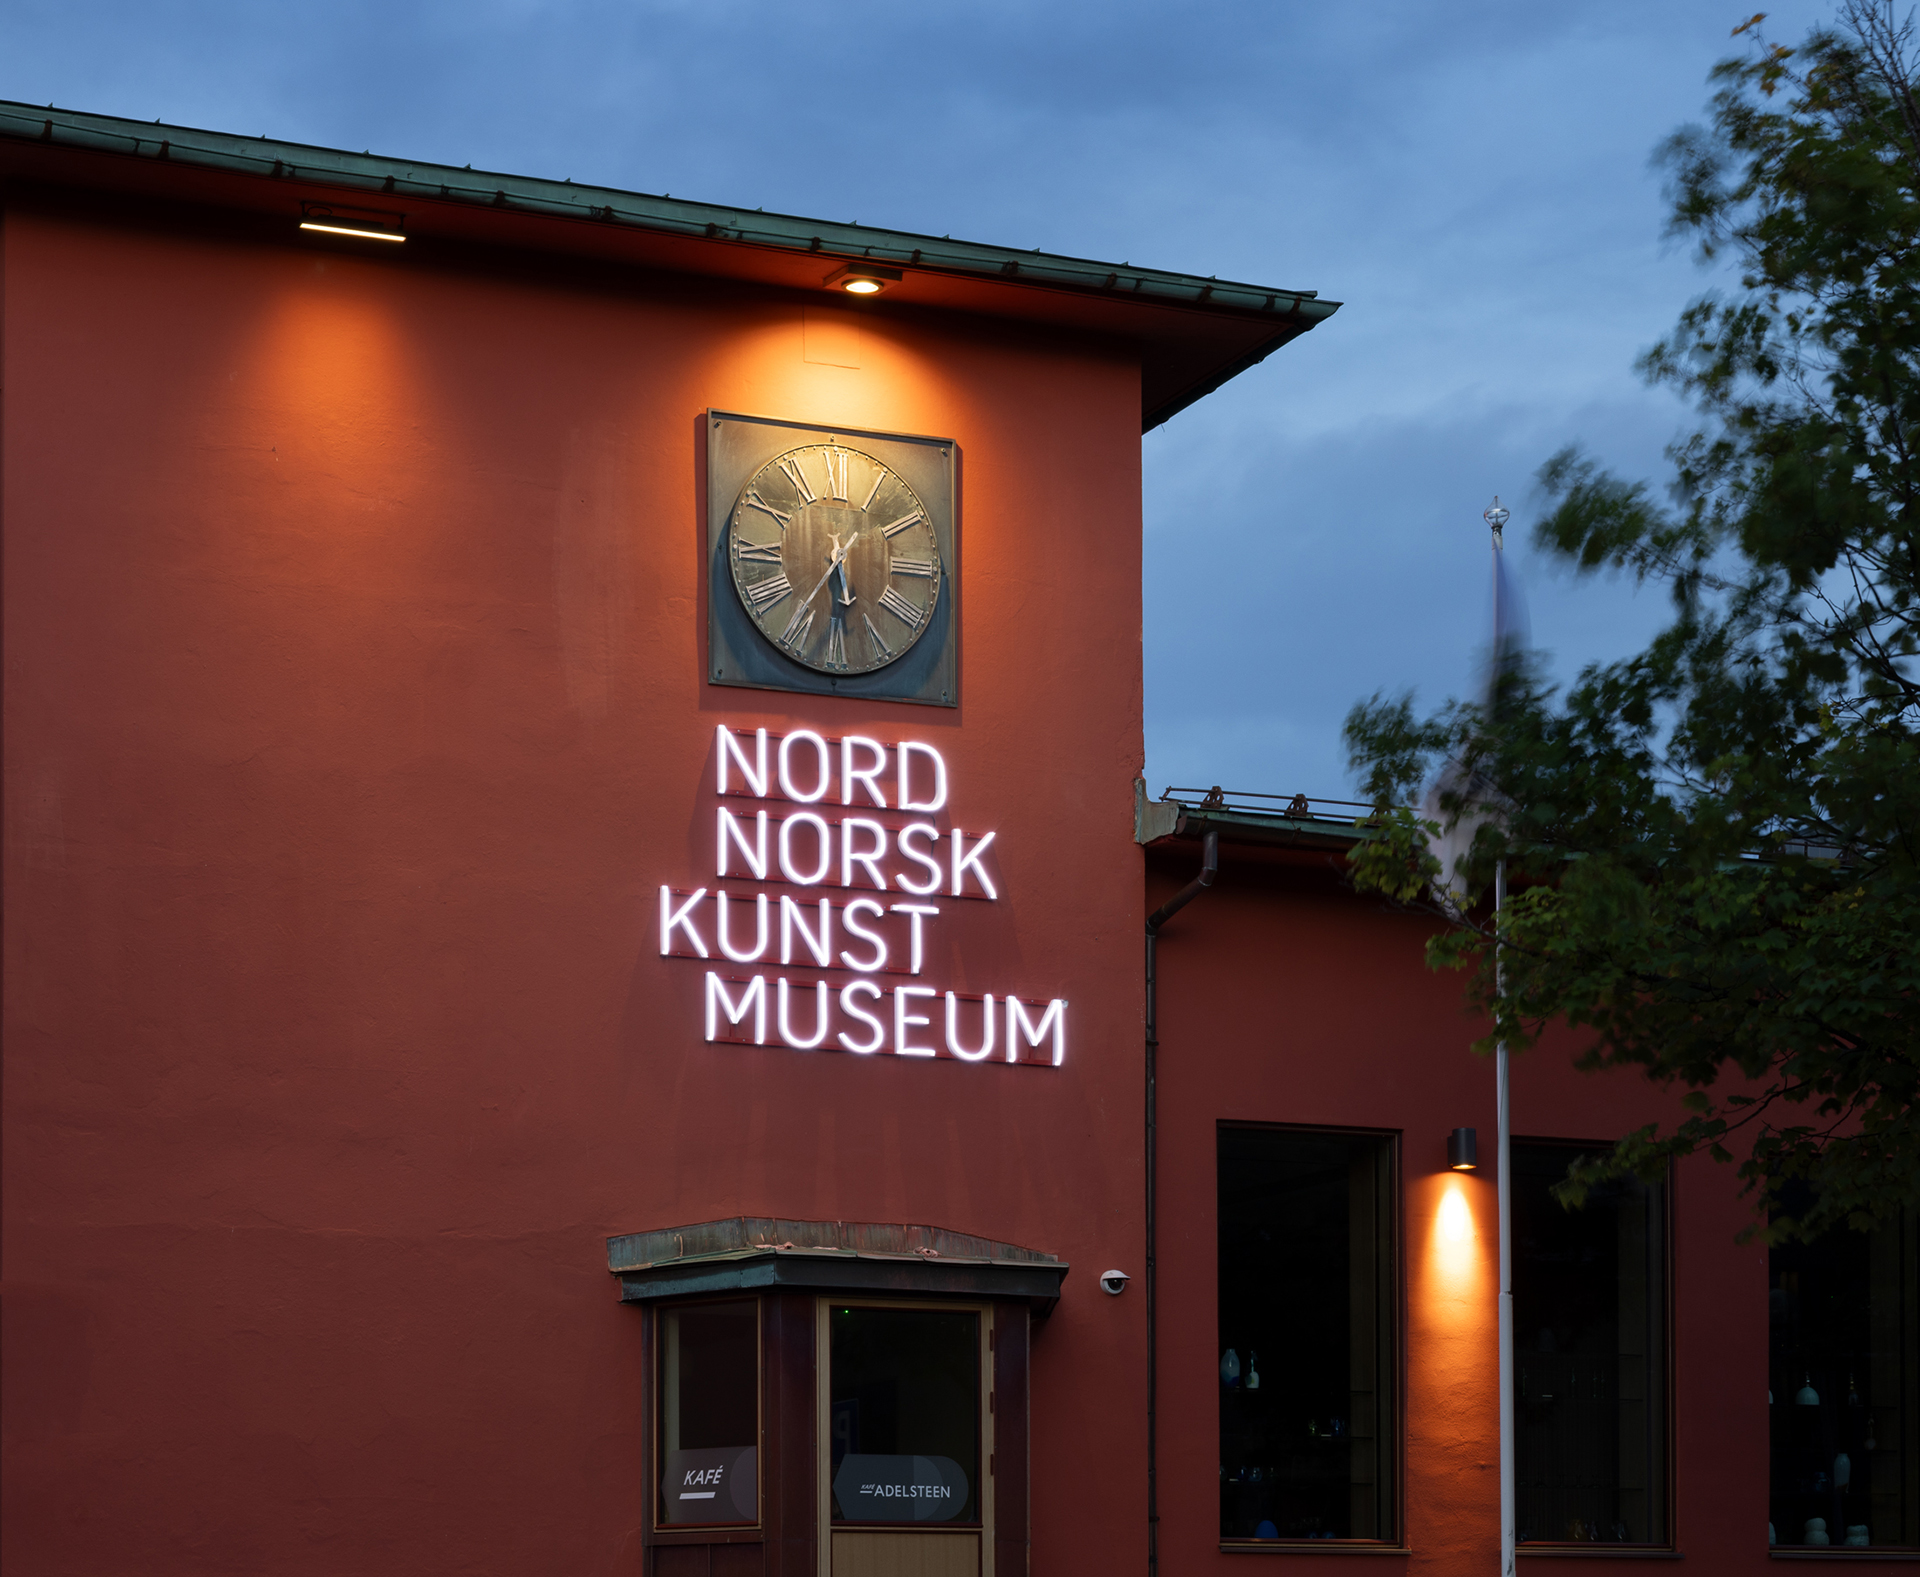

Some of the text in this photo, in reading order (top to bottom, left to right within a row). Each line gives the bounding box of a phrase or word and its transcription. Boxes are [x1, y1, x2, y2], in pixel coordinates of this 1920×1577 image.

[779, 456, 818, 509] XI
[822, 450, 849, 502] XII
[860, 470, 887, 512] I
[747, 490, 793, 530] X
[880, 510, 923, 540] II
[738, 537, 782, 565] IX
[890, 556, 934, 577] III
[745, 572, 793, 616] VIII
[827, 617, 848, 669] VI
[862, 613, 892, 661] V
[716, 724, 948, 812] NORD
[716, 806, 998, 900] NORSK
[659, 885, 940, 975] KUNST
[705, 971, 1064, 1067] MUSEUM
[683, 1464, 723, 1485] KAFÉ
[874, 1484, 951, 1498] ADELSTEEN
